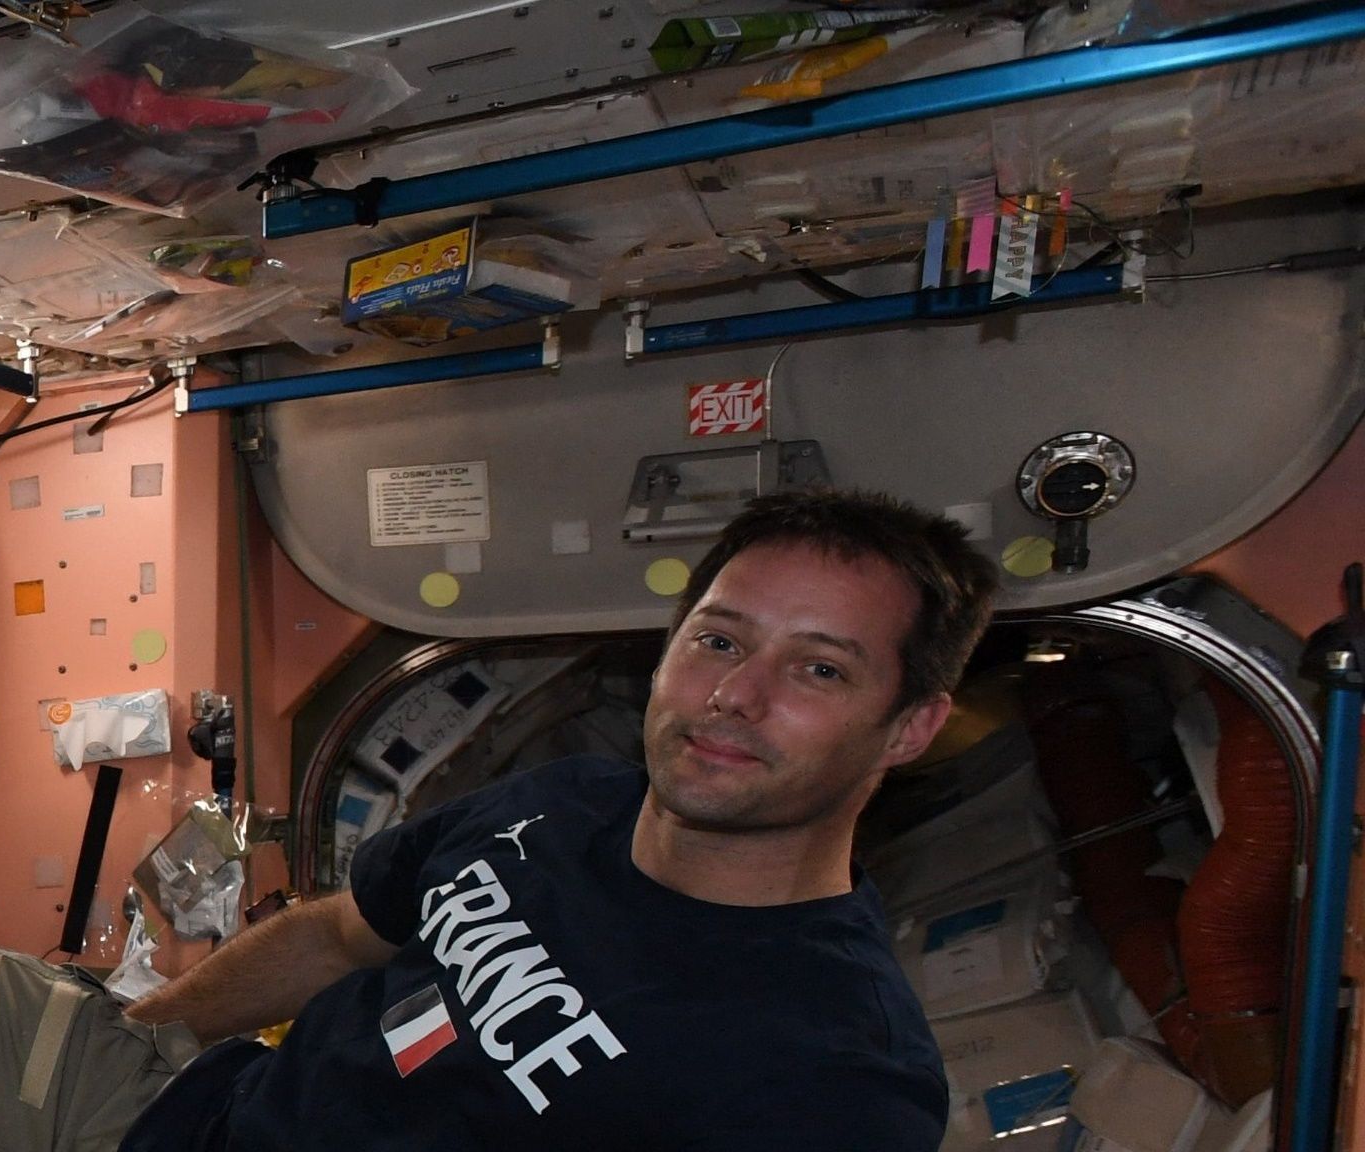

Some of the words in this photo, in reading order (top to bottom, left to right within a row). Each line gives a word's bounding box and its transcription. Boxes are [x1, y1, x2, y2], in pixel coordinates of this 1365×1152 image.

[701, 394, 752, 423] EXIT
[390, 471, 431, 480] CLOSING
[435, 467, 469, 476] HATCH
[418, 859, 628, 1115] FRANCE
